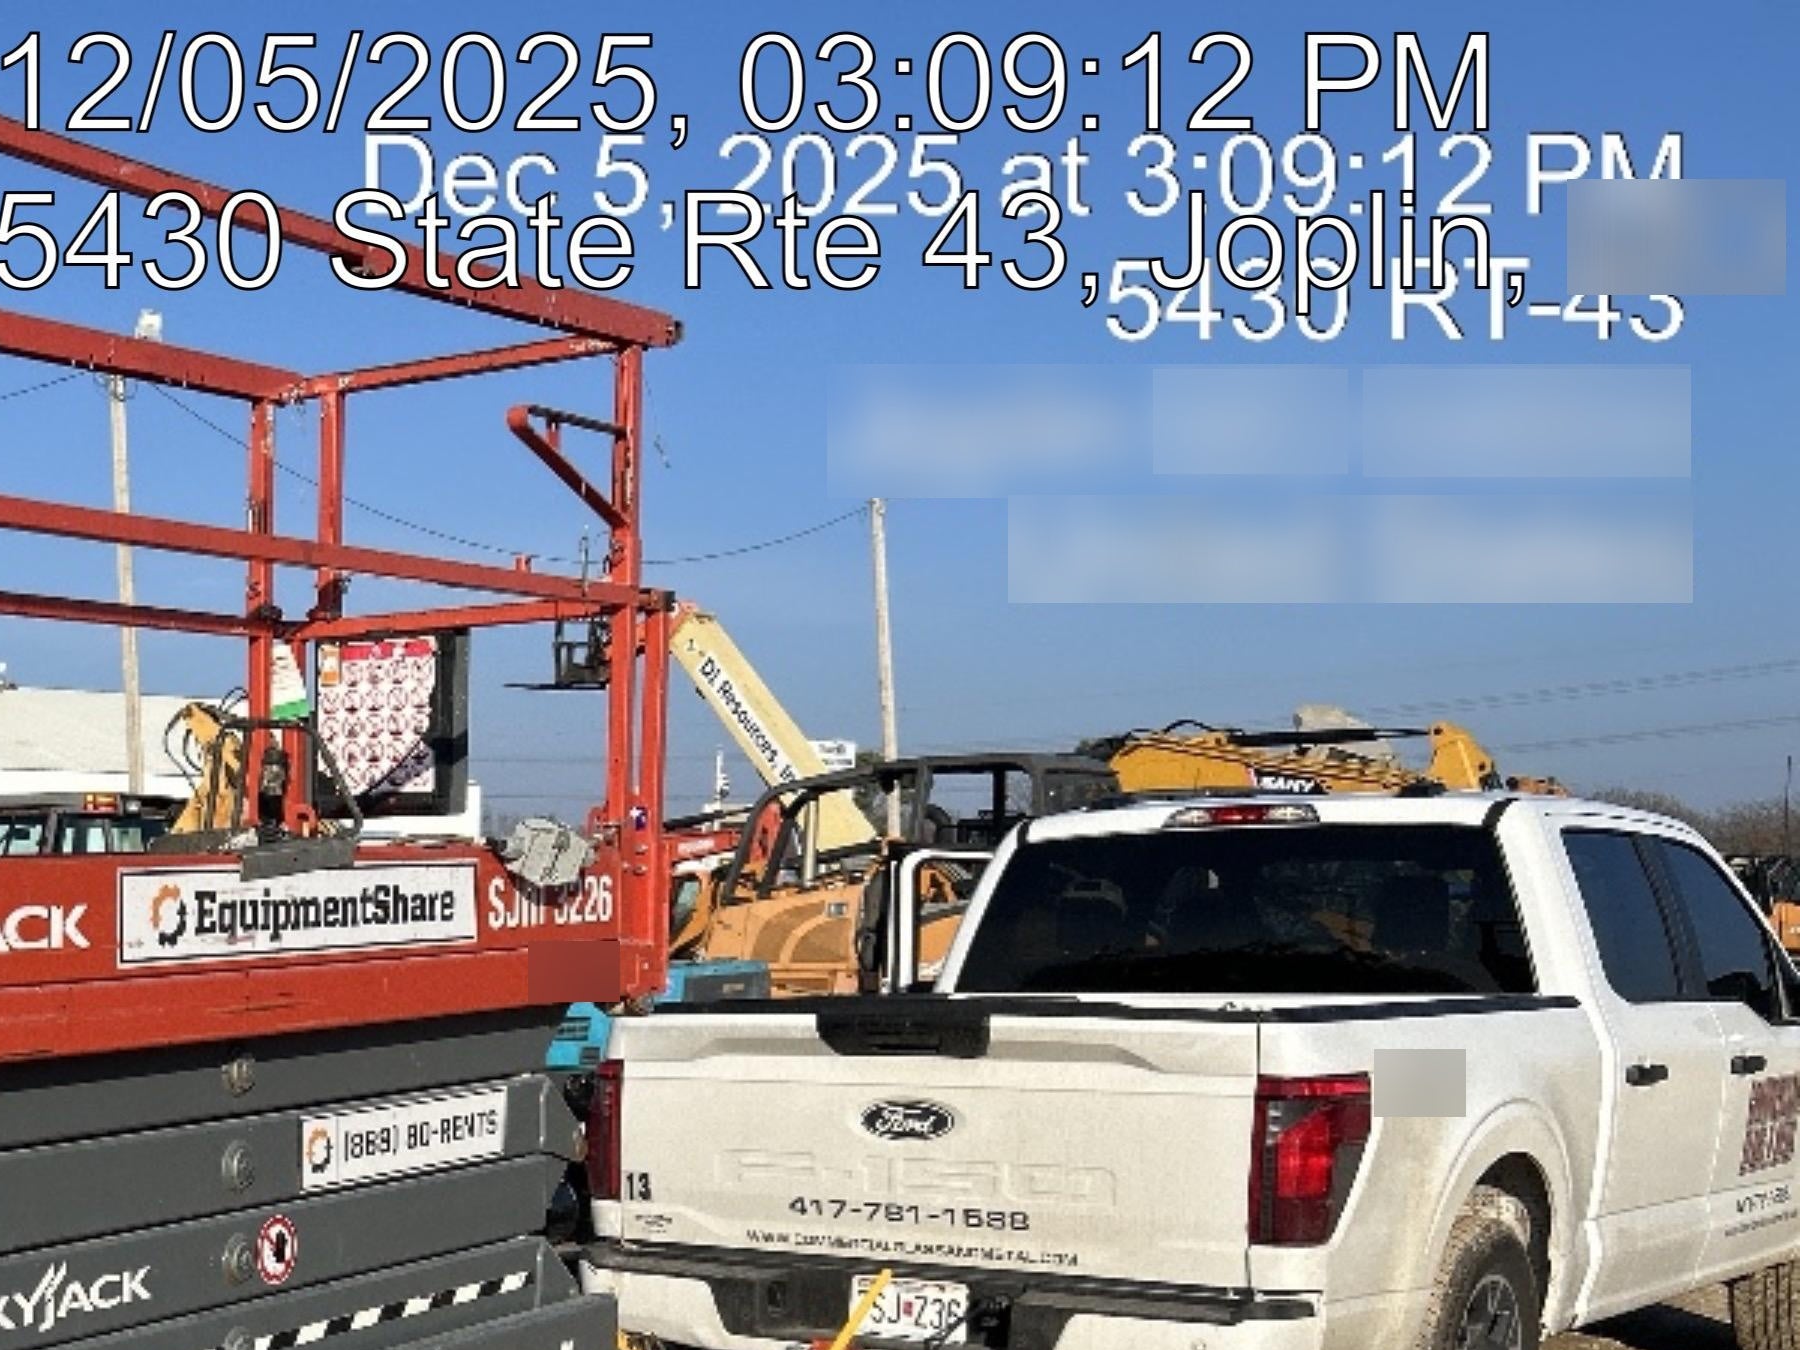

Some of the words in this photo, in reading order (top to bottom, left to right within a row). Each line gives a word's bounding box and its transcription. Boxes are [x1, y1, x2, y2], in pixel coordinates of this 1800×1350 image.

[194, 884, 454, 942] EquipmentShare
[874, 1106, 938, 1134] Ford
[626, 1172, 652, 1201] 13
